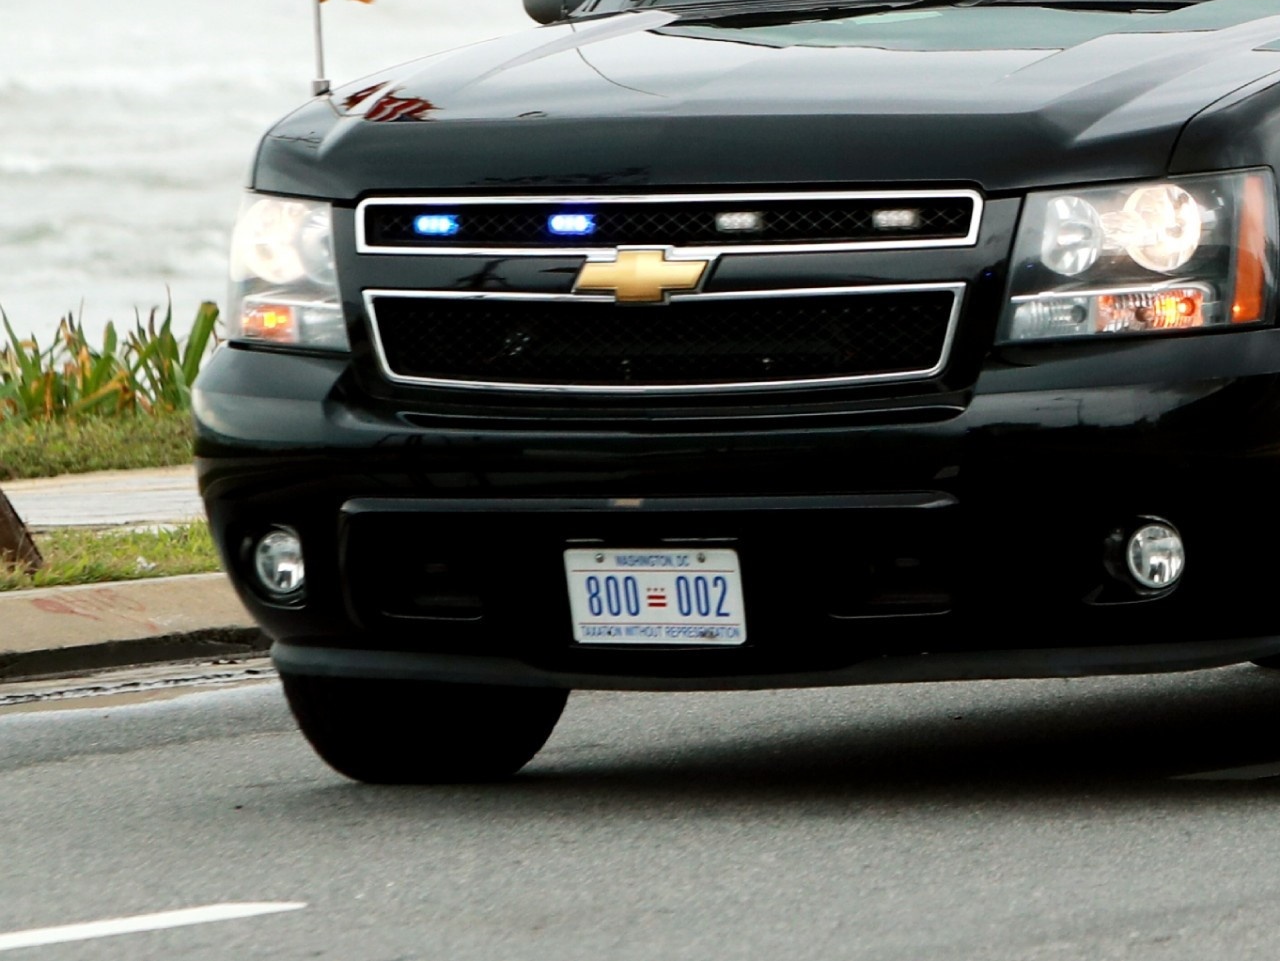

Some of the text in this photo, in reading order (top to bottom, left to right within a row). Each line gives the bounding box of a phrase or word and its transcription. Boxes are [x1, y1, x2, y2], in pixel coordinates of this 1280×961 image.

[586, 575, 730, 617] 800 002
[625, 626, 663, 638] WITHOUT
